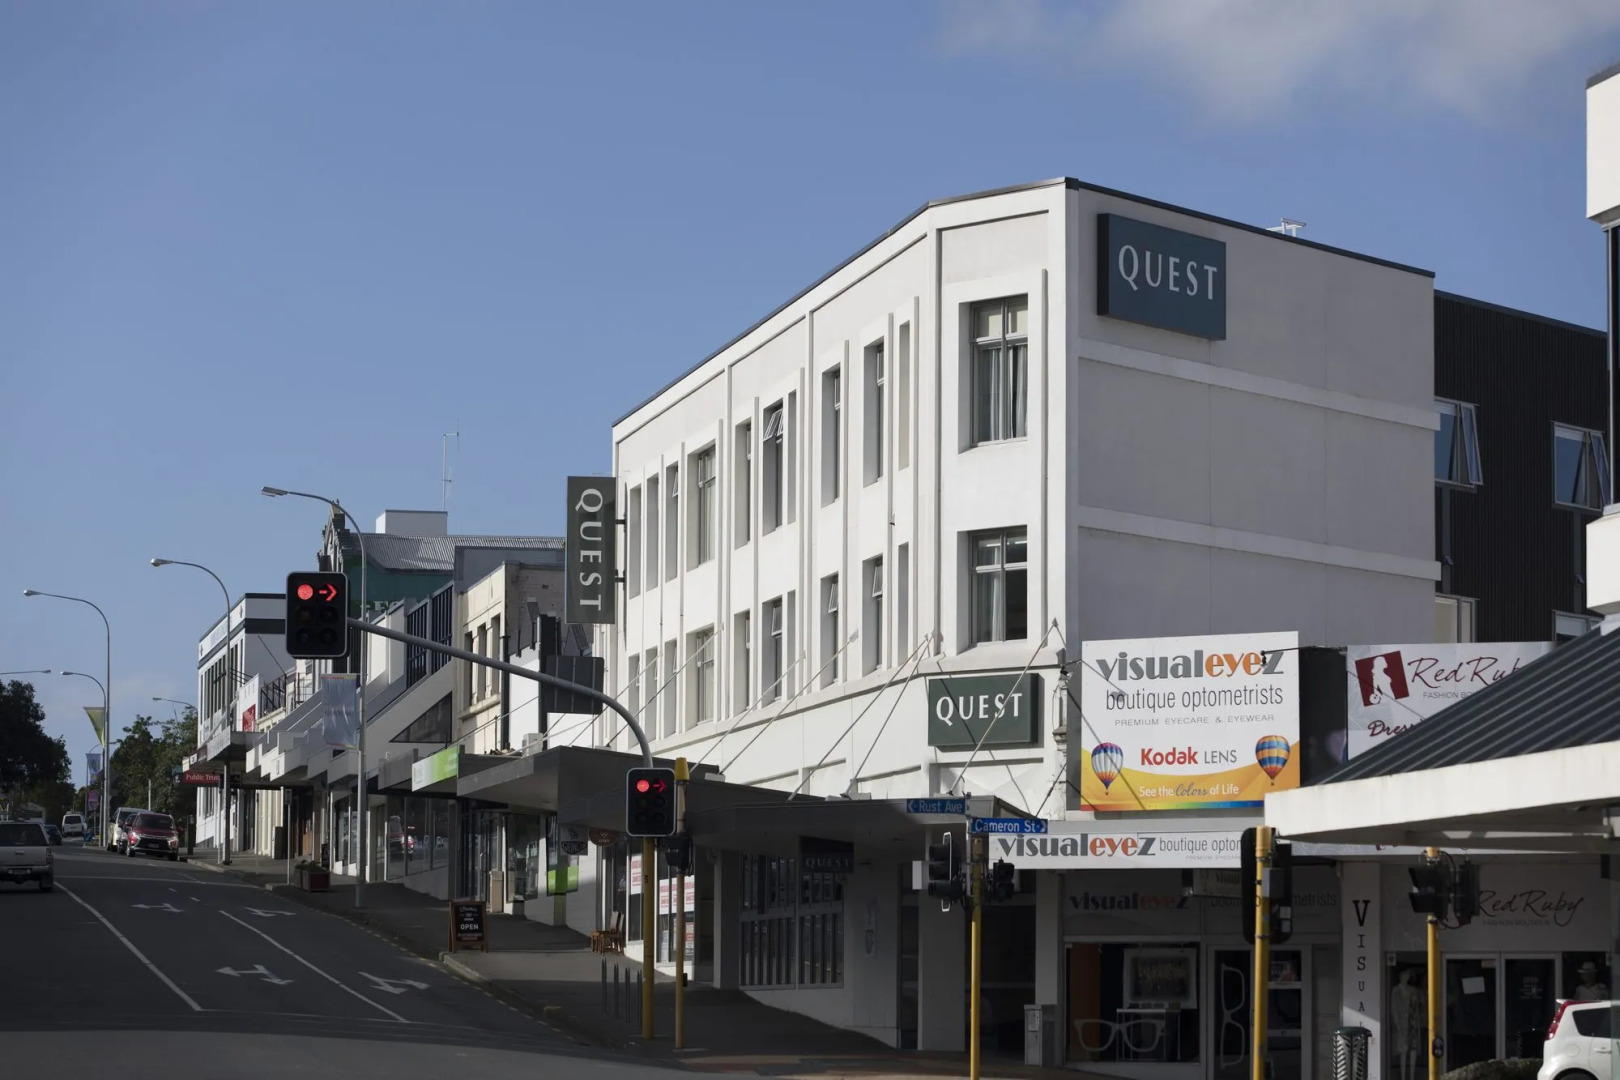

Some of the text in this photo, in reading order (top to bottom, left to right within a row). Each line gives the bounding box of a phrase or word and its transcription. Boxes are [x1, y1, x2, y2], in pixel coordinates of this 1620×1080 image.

[1118, 244, 1218, 300] QUEST
[575, 488, 603, 611] QUEST
[1095, 649, 1285, 681] visualeyez
[1407, 656, 1522, 688] Red Rub
[936, 692, 1022, 726] QUEST
[1106, 684, 1284, 713] boutique optometrists
[1115, 718, 1159, 726] PREMIUM
[1165, 716, 1209, 725] EYECARE
[1227, 714, 1275, 723] EYEWEAR
[1141, 747, 1237, 766] Kodak LENS
[1139, 783, 1240, 797] See the Colors of Life
[919, 801, 963, 813] Rust Ave
[975, 819, 1036, 832] Cameron St
[998, 833, 1156, 857] visualeyez
[1159, 836, 1208, 853] boutique
[805, 857, 849, 869] QUEST
[1517, 890, 1585, 927] Ruby
